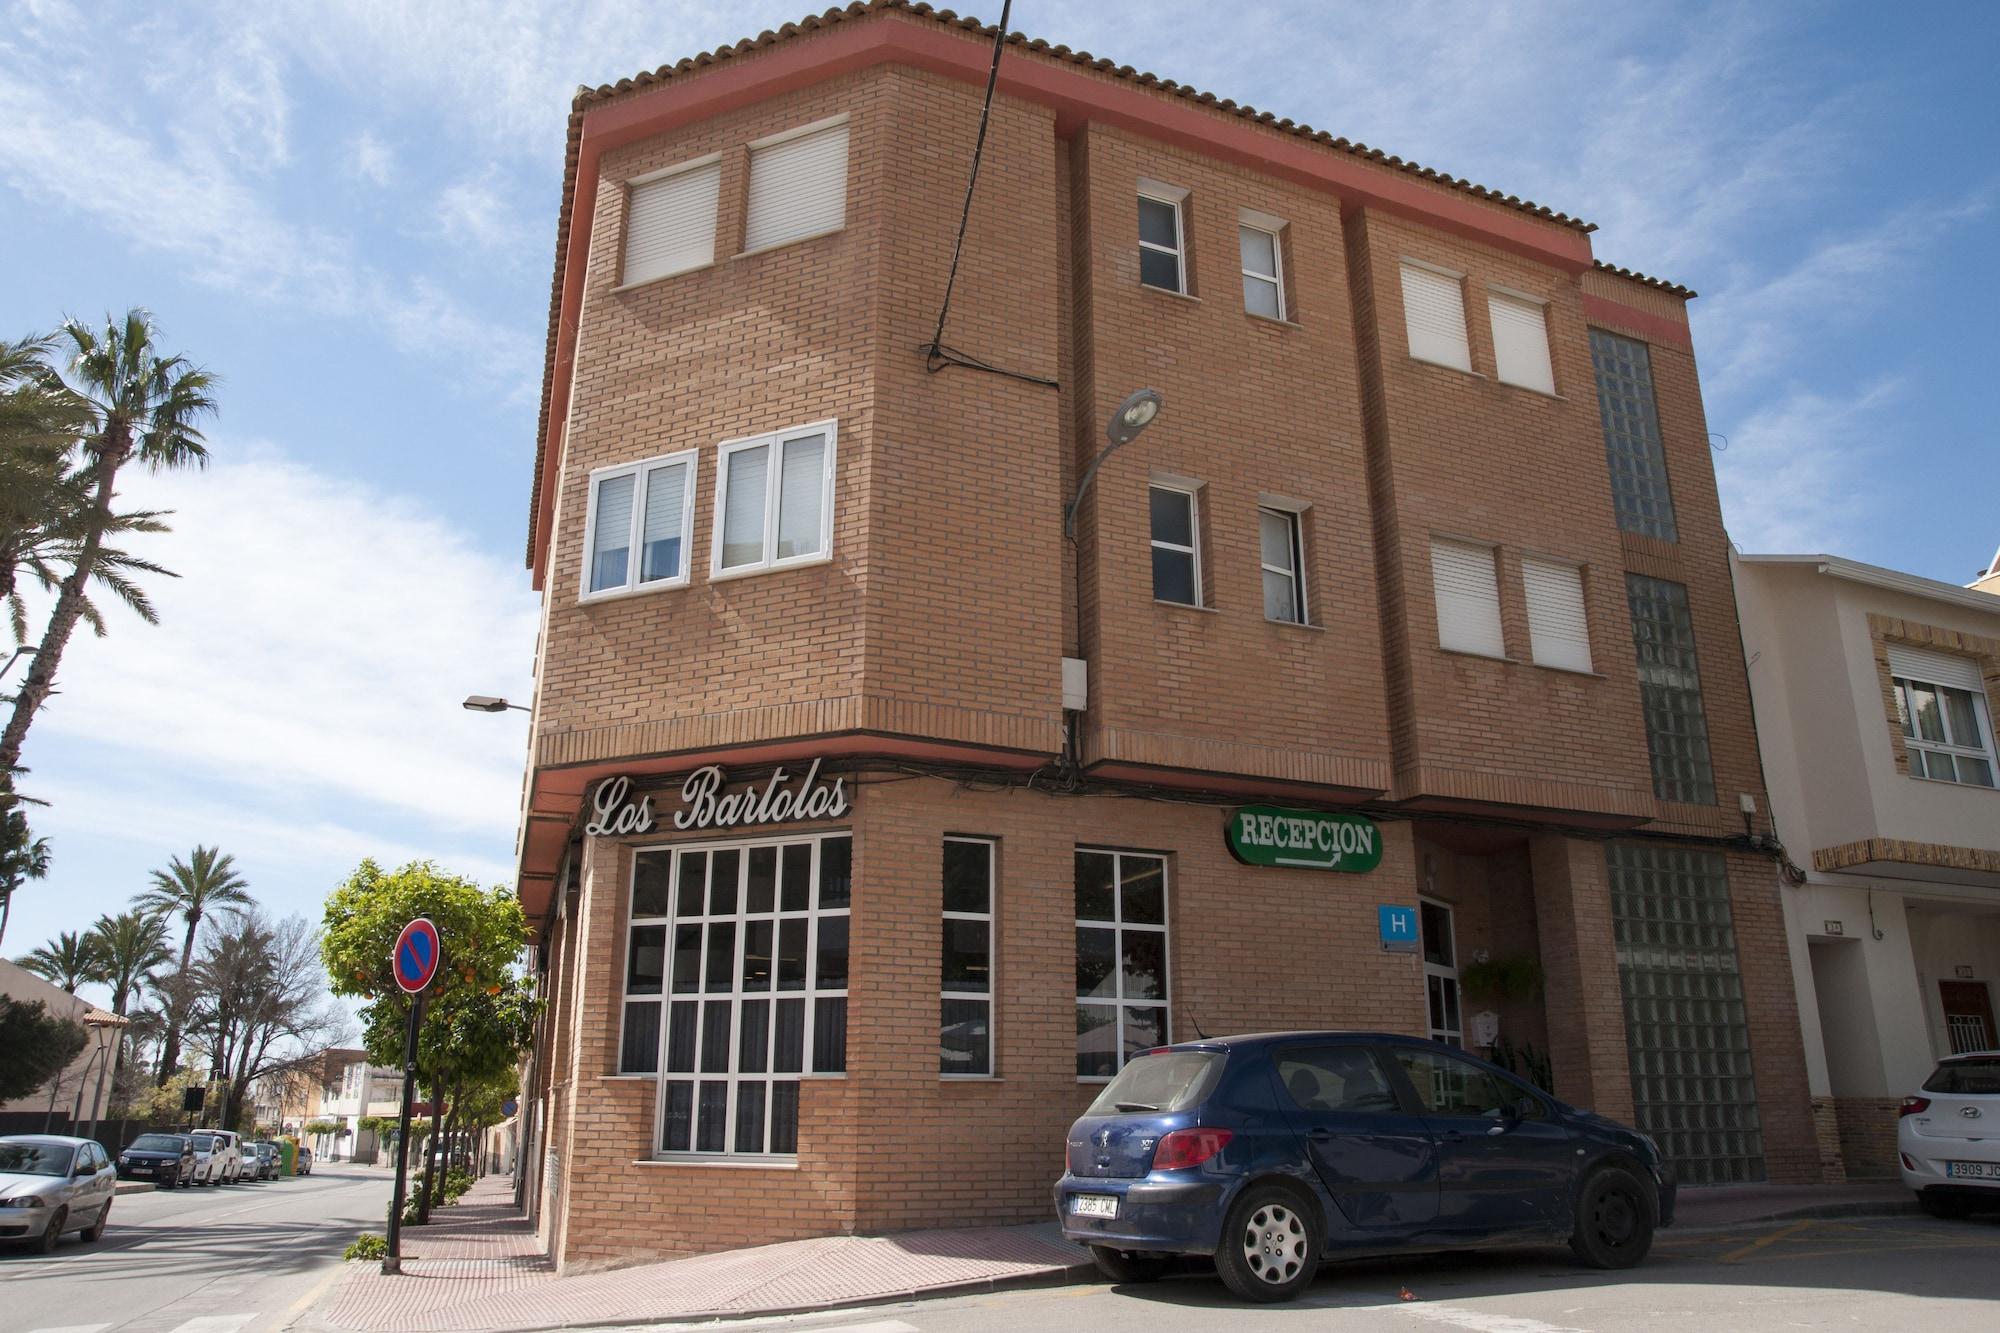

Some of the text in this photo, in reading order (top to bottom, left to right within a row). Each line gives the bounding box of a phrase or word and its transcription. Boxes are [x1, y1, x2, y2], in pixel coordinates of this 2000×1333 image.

[586, 757, 848, 836] Los Bartolos
[1240, 813, 1373, 854] RECEPCION
[1392, 914, 1406, 932] H
[1954, 1164, 1983, 1176] 3909
